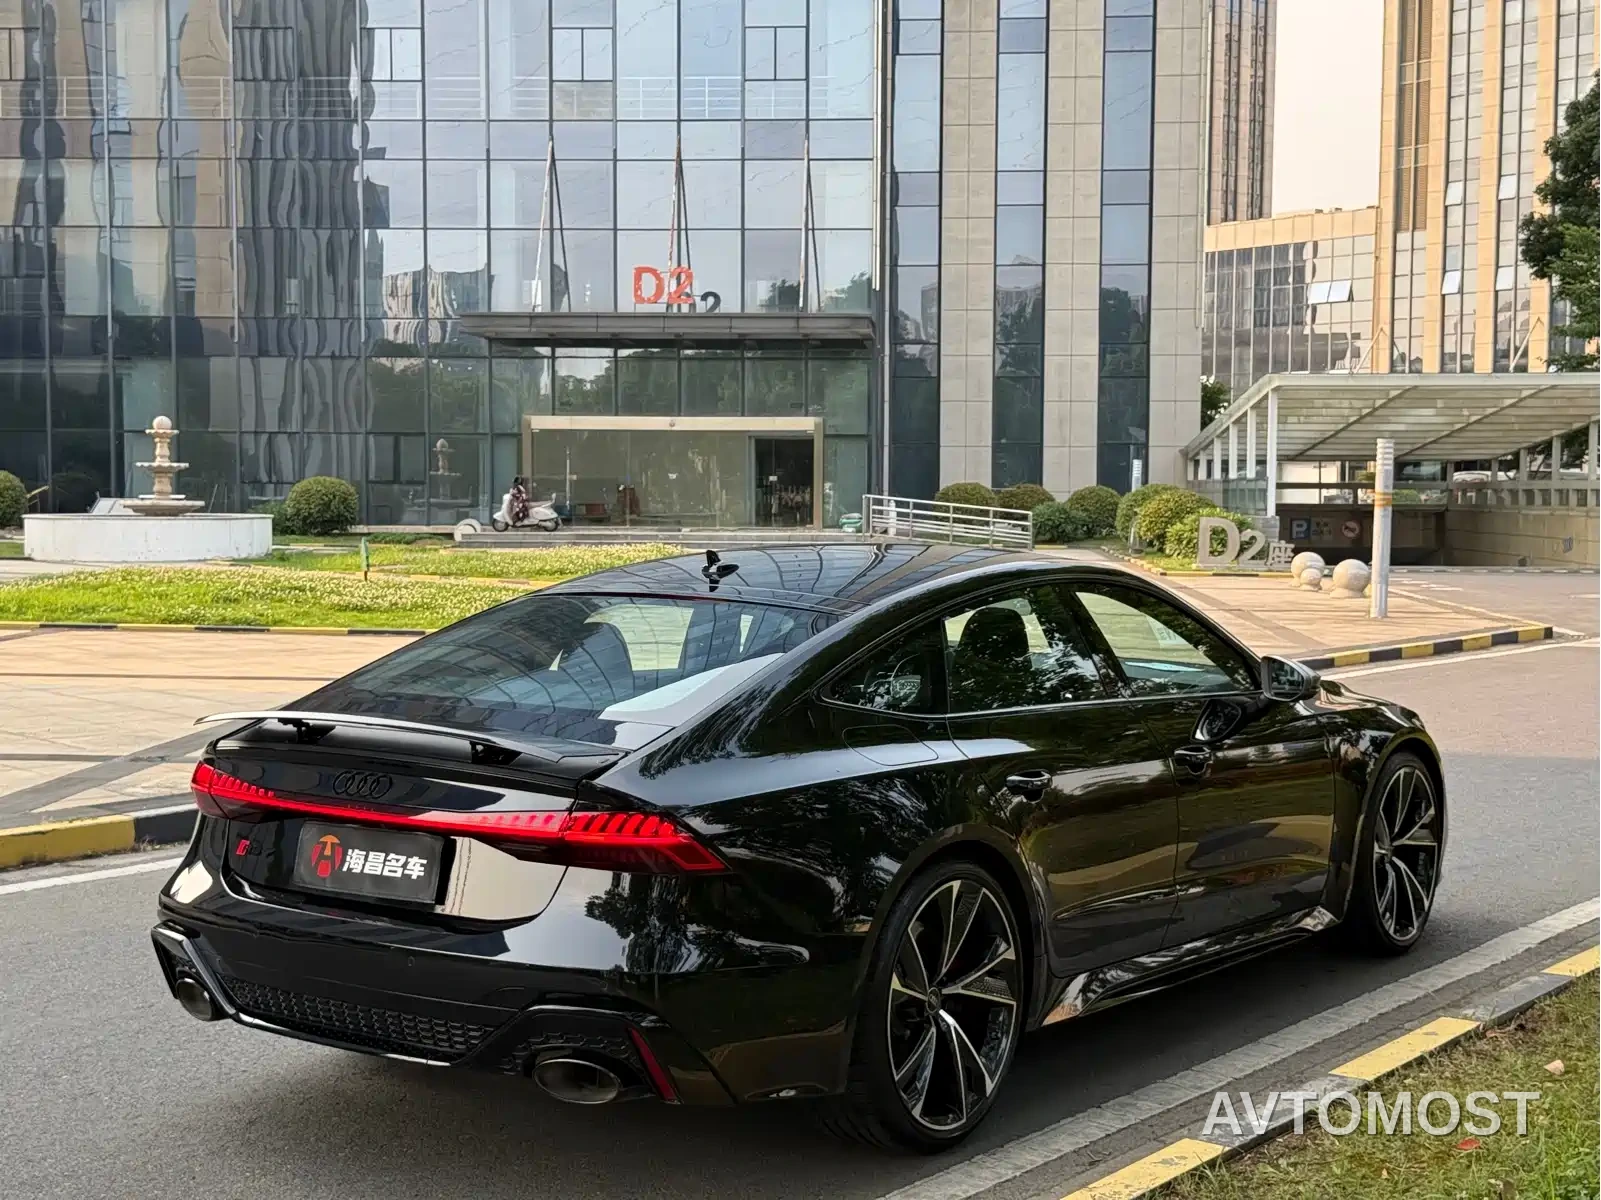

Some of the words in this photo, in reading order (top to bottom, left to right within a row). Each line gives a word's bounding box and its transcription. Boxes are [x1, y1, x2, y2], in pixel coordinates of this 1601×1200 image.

[633, 266, 693, 304] D2
[1291, 520, 1308, 539] P
[342, 848, 428, 880] 海昌名车
